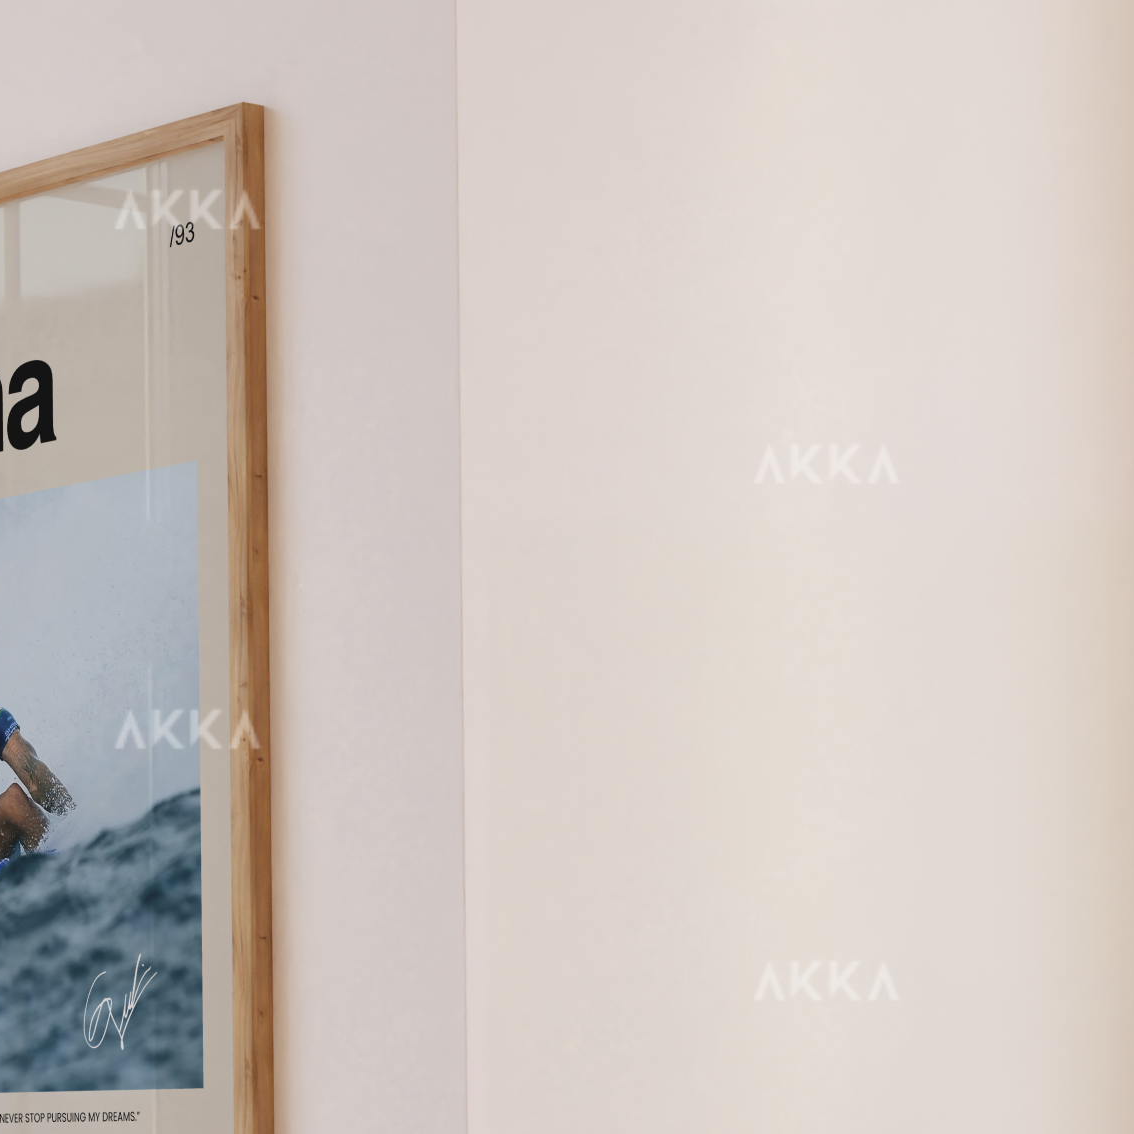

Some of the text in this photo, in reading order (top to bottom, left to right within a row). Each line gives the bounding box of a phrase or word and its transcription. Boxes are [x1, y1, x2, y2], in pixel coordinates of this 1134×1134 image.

[169, 221, 195, 248] /93
[0, 1113, 23, 1123] NEVER
[25, 1113, 45, 1123] STOP
[47, 1112, 86, 1123] PURSUING
[88, 1112, 100, 1122] MY
